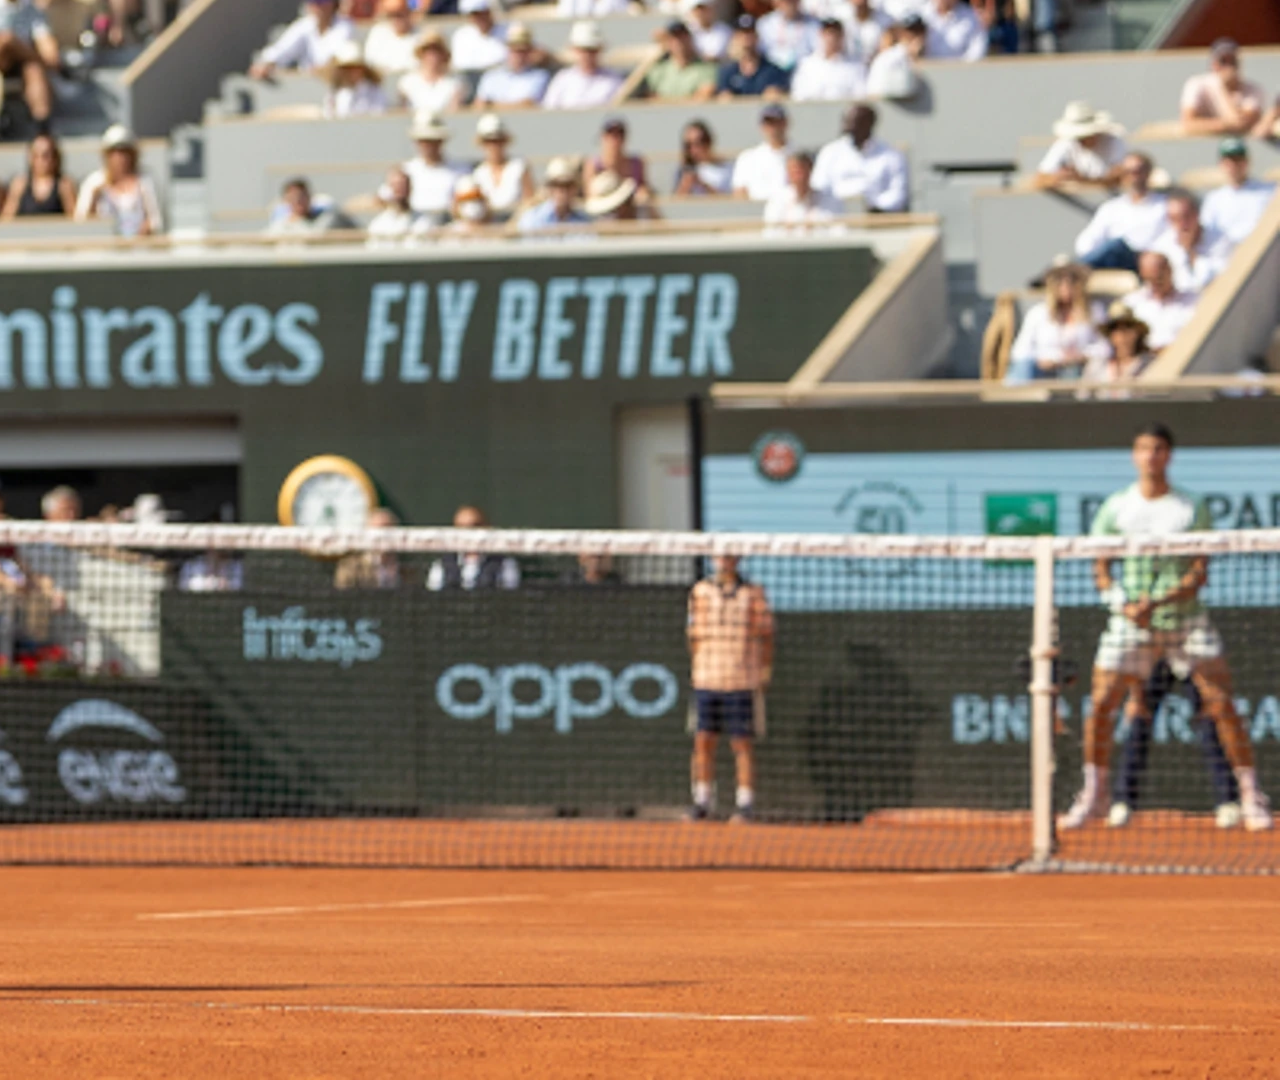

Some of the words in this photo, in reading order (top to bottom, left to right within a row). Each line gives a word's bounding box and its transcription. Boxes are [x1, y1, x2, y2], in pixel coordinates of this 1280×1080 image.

[362, 282, 478, 384] FLY
[491, 272, 739, 381] BETTER
[436, 661, 679, 734] oppo
